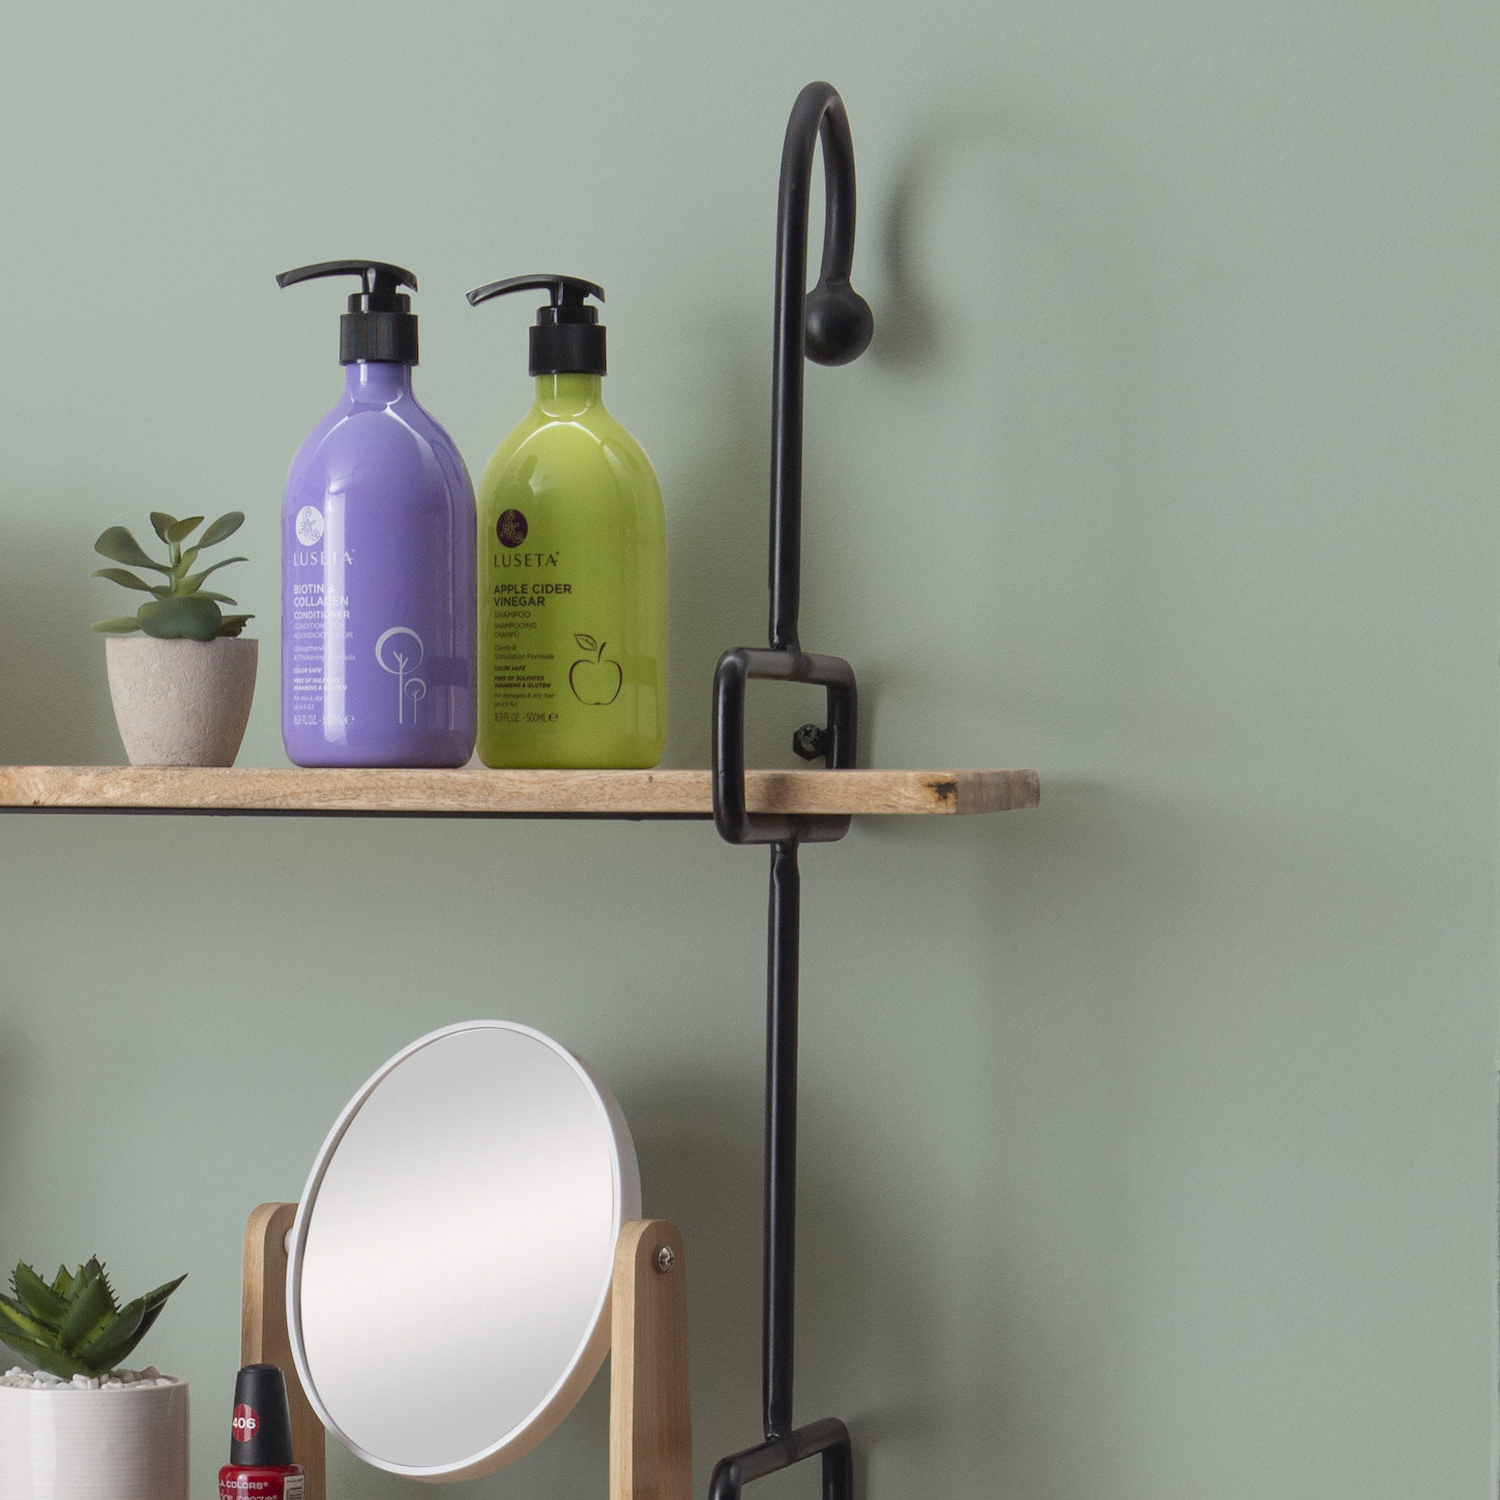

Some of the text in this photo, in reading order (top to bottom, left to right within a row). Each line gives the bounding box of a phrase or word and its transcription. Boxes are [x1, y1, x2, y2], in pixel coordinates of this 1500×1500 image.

[294, 551, 353, 566] LUSETA
[494, 553, 558, 567] LUSETA
[294, 584, 324, 594] BIOTIN
[494, 584, 572, 594] APPLE CIDER
[294, 596, 349, 607] COLLAGEN
[494, 596, 545, 606] VINEGAR
[294, 610, 350, 619] CONDITIONER
[232, 1417, 256, 1429] 406
[226, 1481, 263, 1489] COLORS
